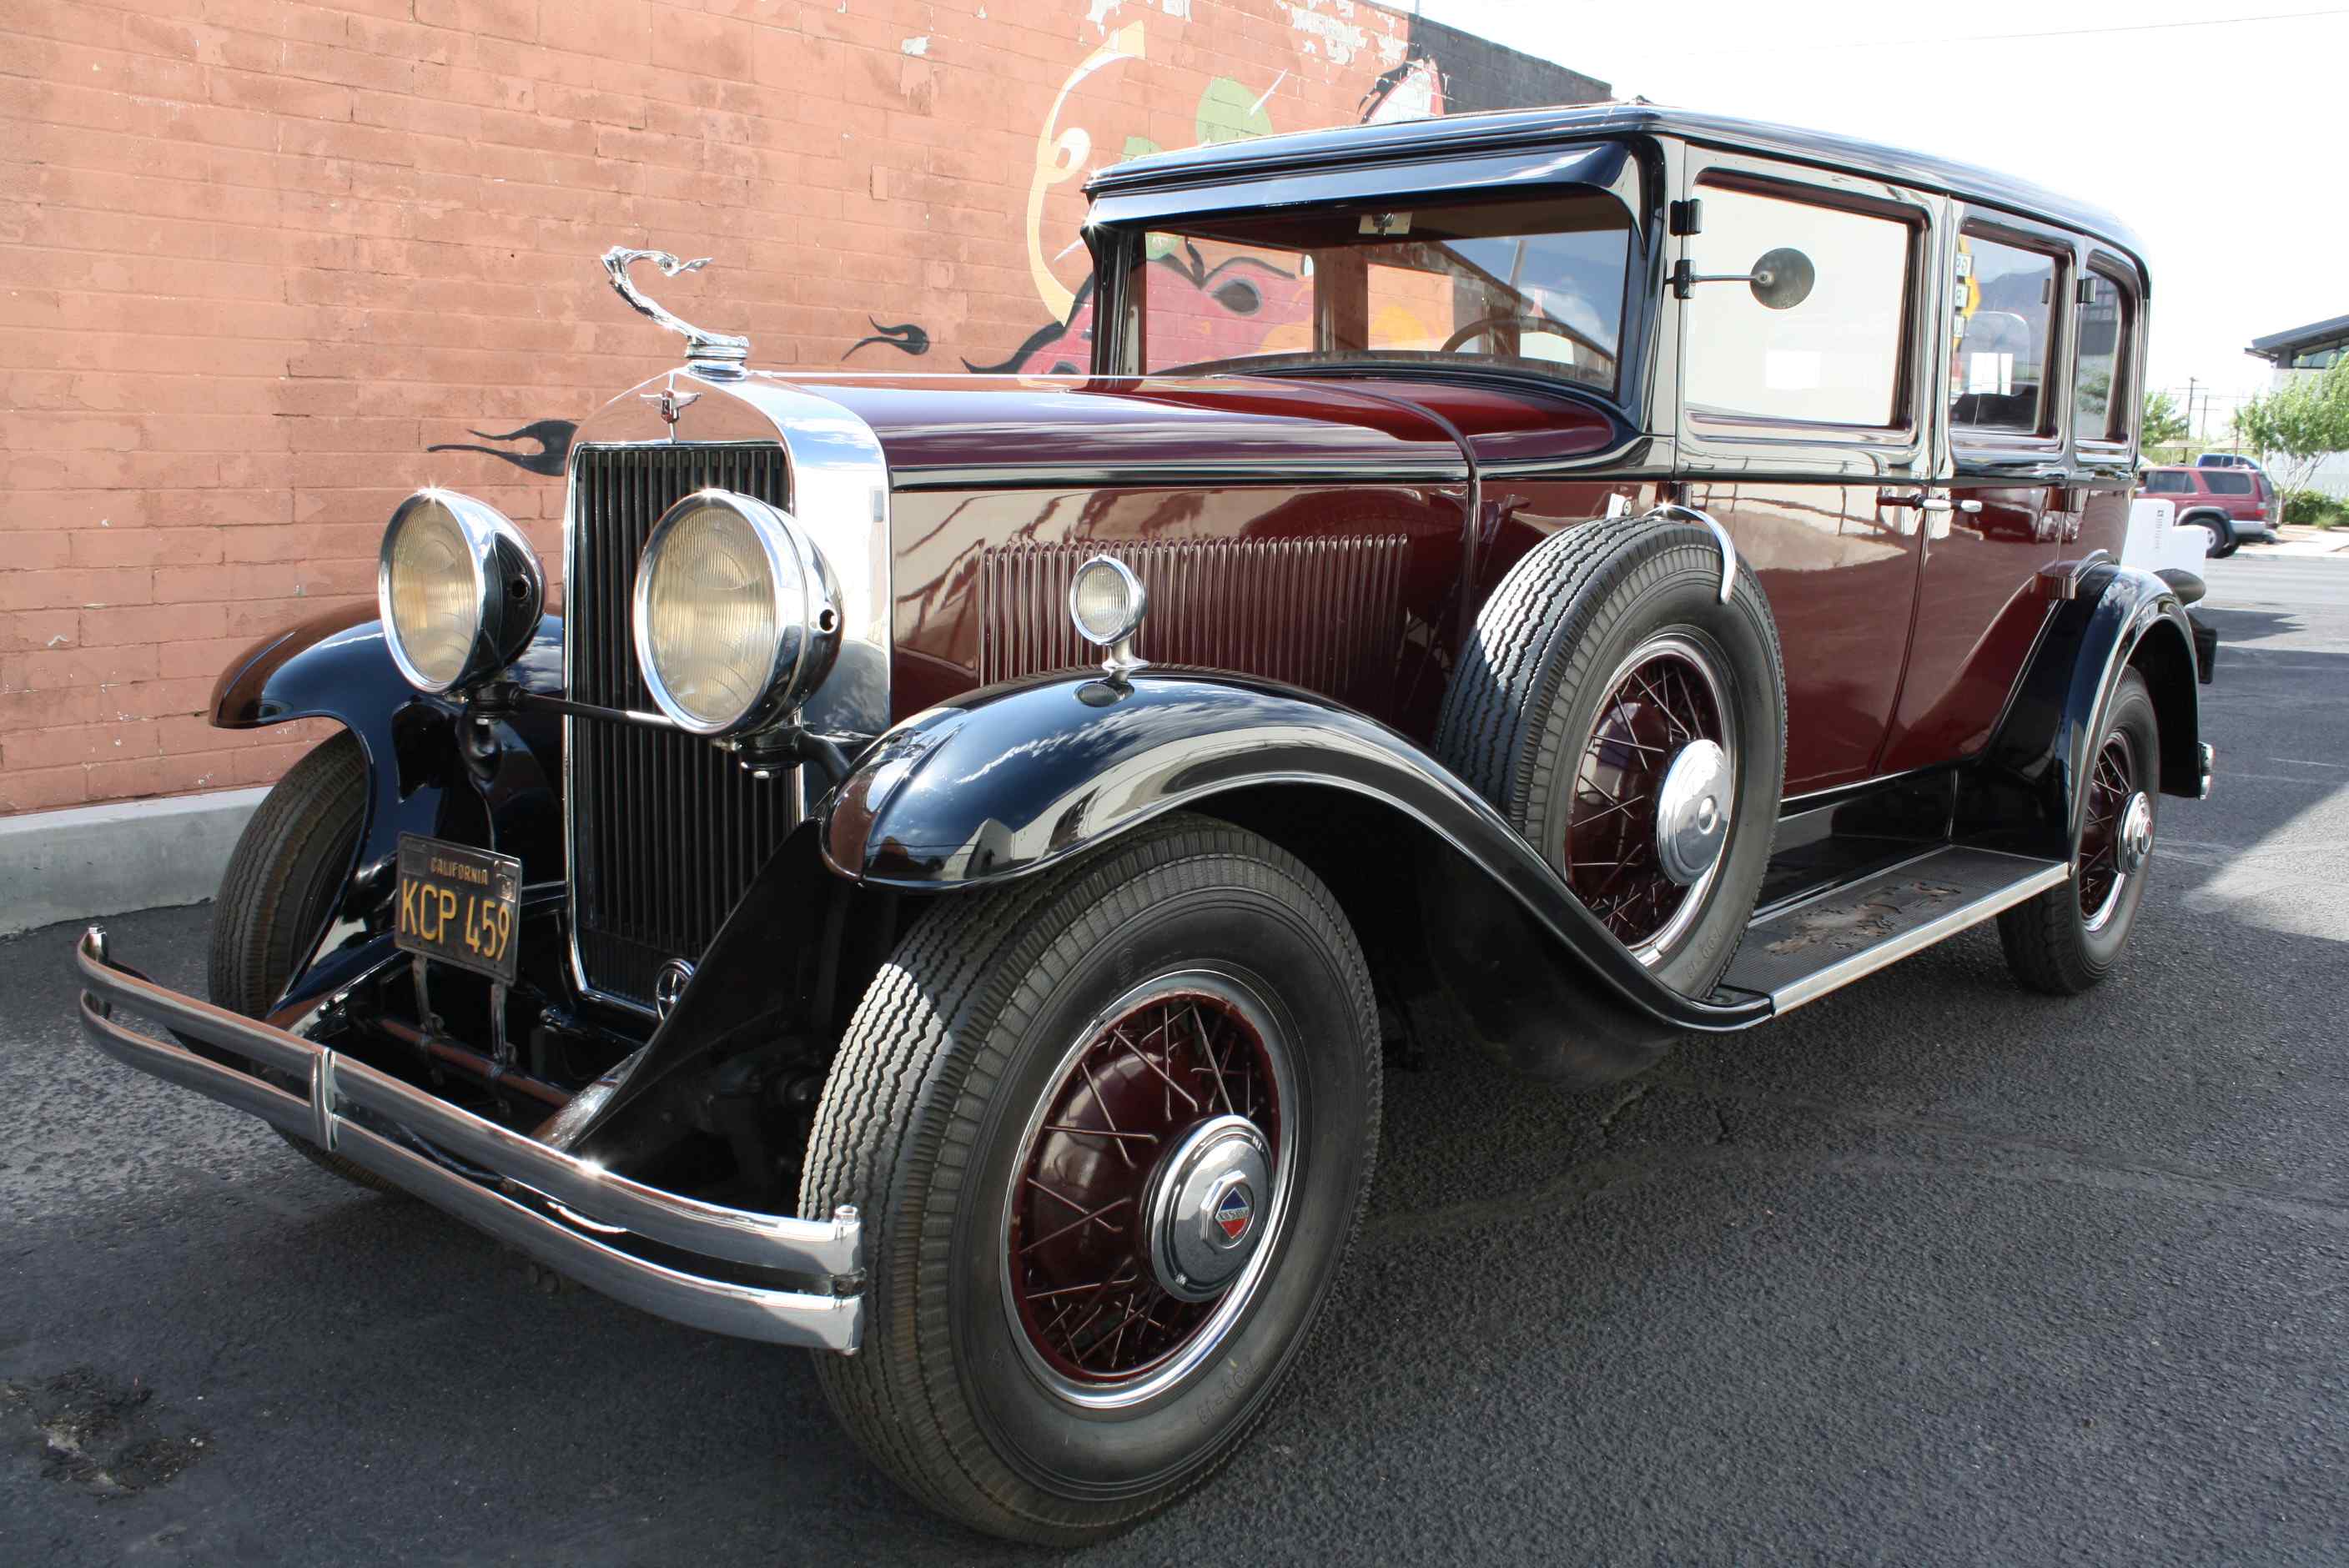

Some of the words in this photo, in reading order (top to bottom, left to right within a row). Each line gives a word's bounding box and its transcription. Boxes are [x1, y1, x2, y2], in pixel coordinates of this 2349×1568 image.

[430, 857, 488, 885] CALIFORNIA
[401, 878, 457, 945] KCP
[465, 896, 510, 962] 459
